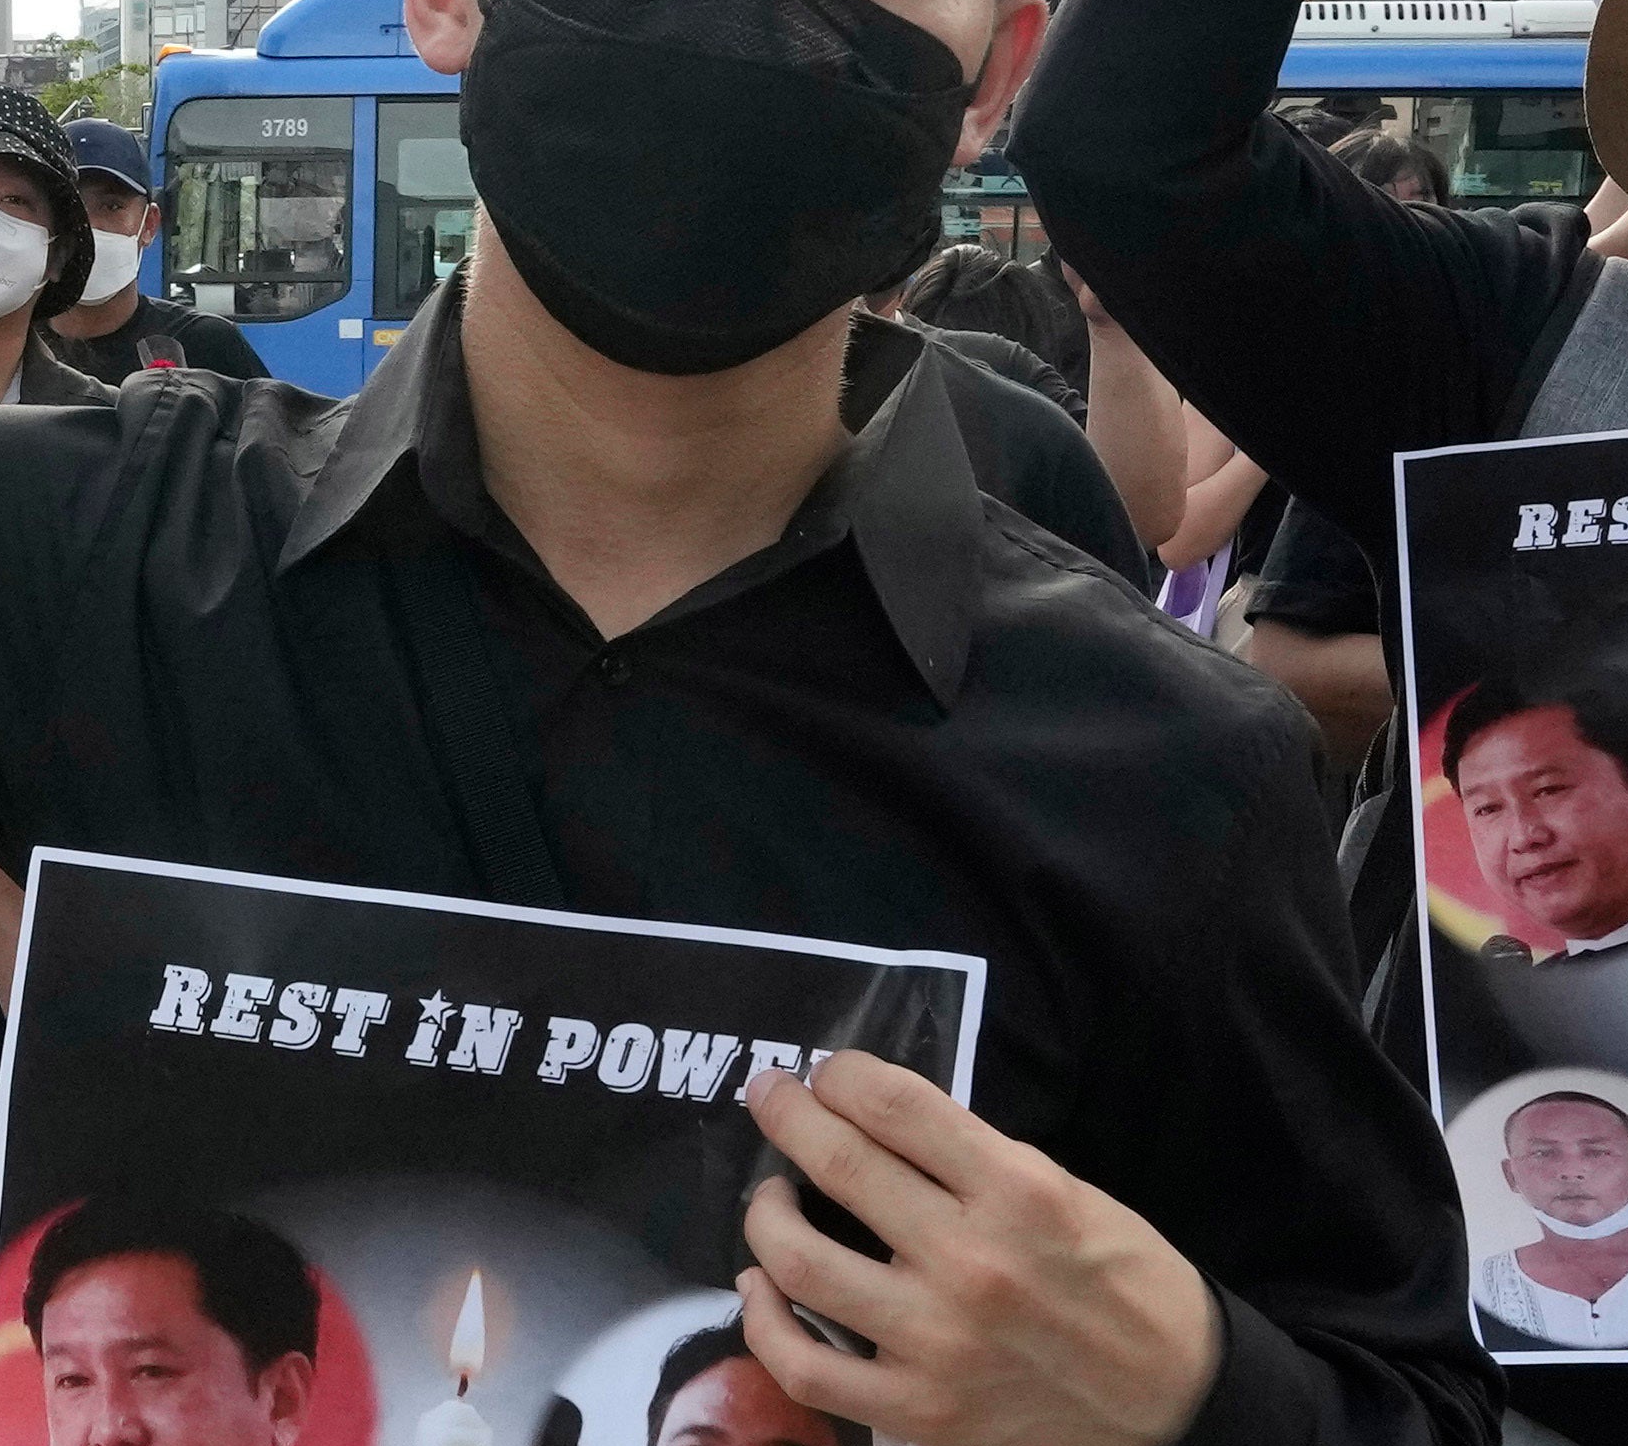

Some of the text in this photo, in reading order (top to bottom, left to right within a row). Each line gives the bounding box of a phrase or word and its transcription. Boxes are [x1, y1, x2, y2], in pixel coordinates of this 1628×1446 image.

[261, 118, 309, 138] 3789
[149, 963, 388, 1058] REST
[537, 1016, 832, 1108] POWE
